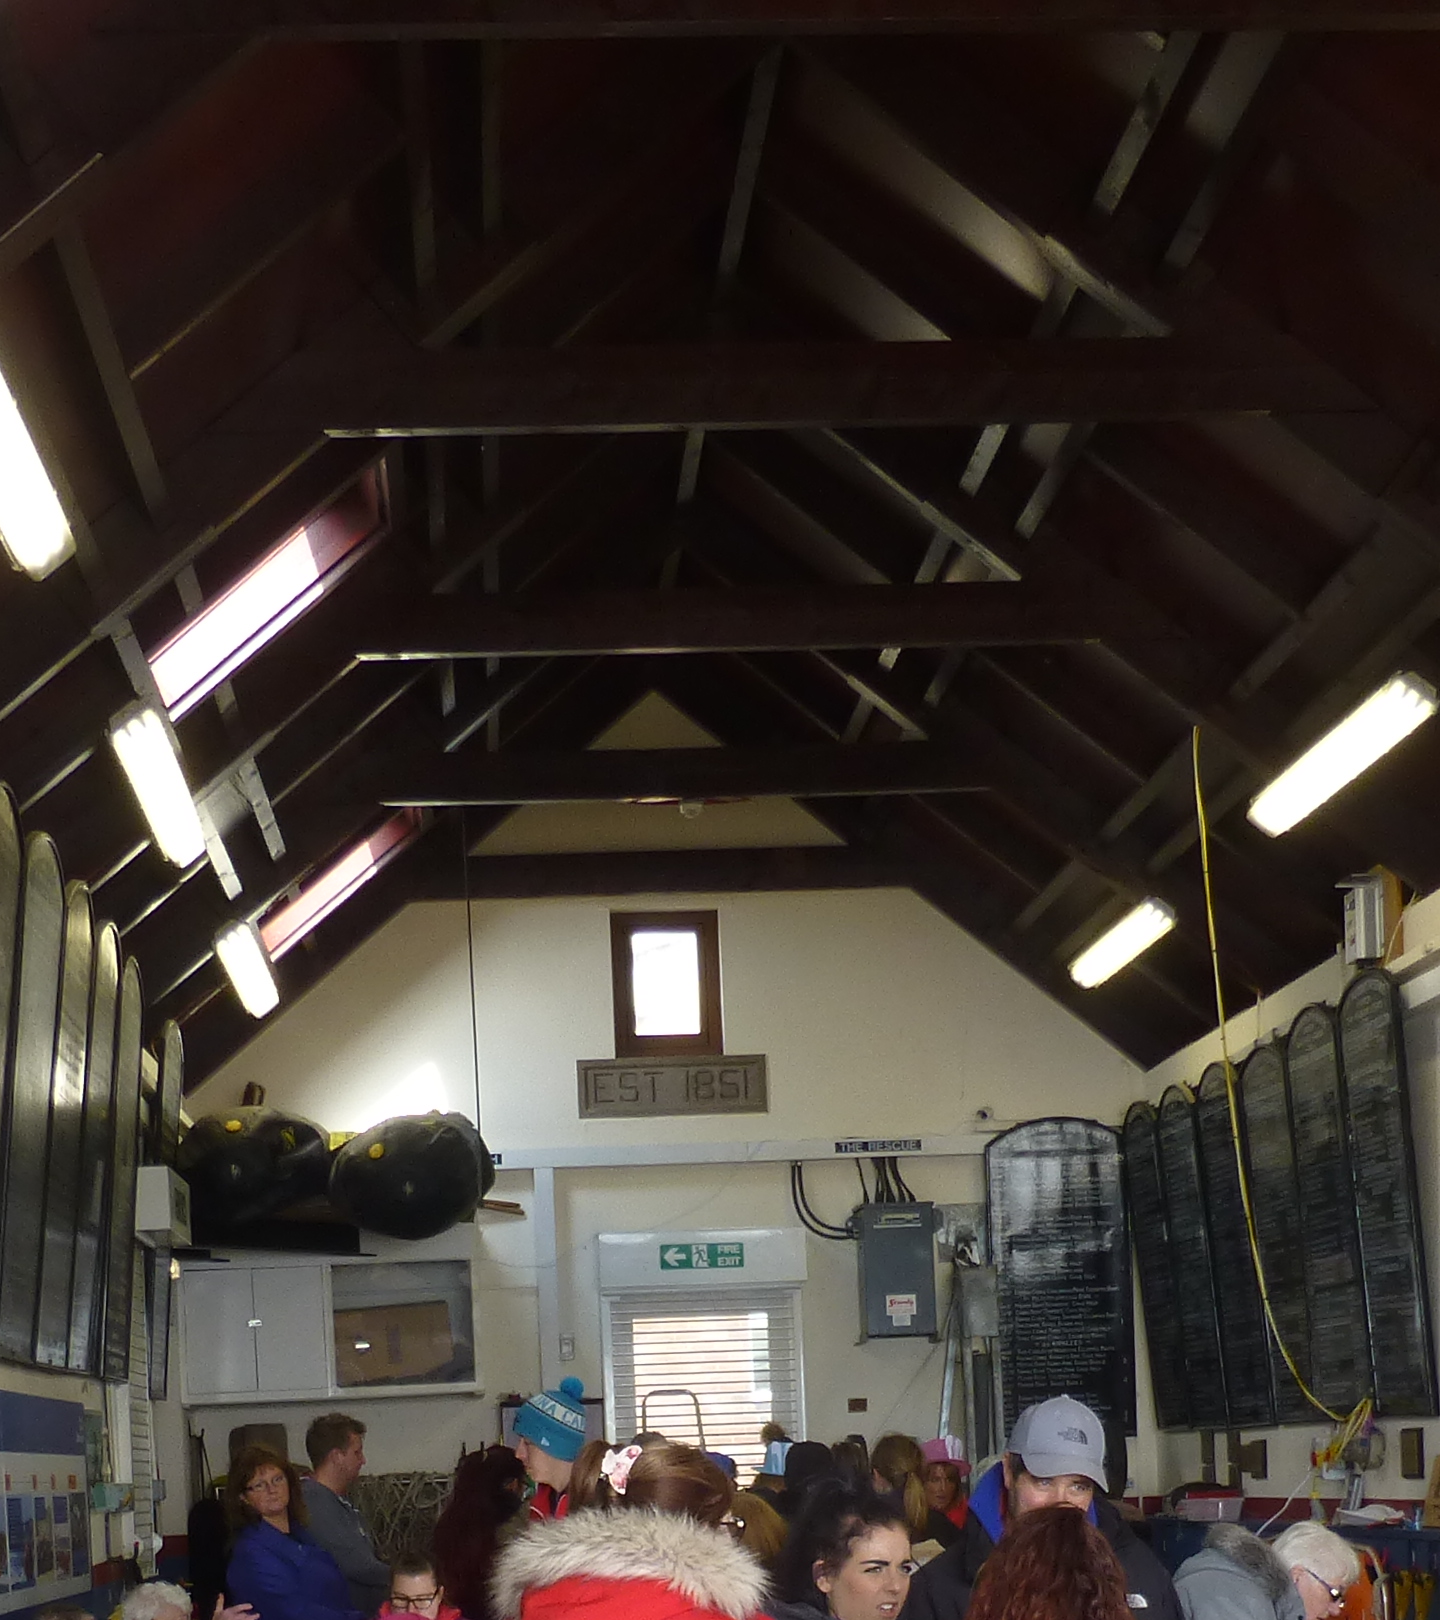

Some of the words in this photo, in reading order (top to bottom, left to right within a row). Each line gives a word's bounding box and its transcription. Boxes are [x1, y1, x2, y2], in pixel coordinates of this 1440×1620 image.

[594, 1071, 664, 1102] EST
[686, 1069, 748, 1102] 1851
[840, 1142, 864, 1152] THE
[868, 1140, 918, 1152] RESCUE
[717, 1244, 740, 1254] FIRE
[717, 1256, 741, 1267] EXIT
